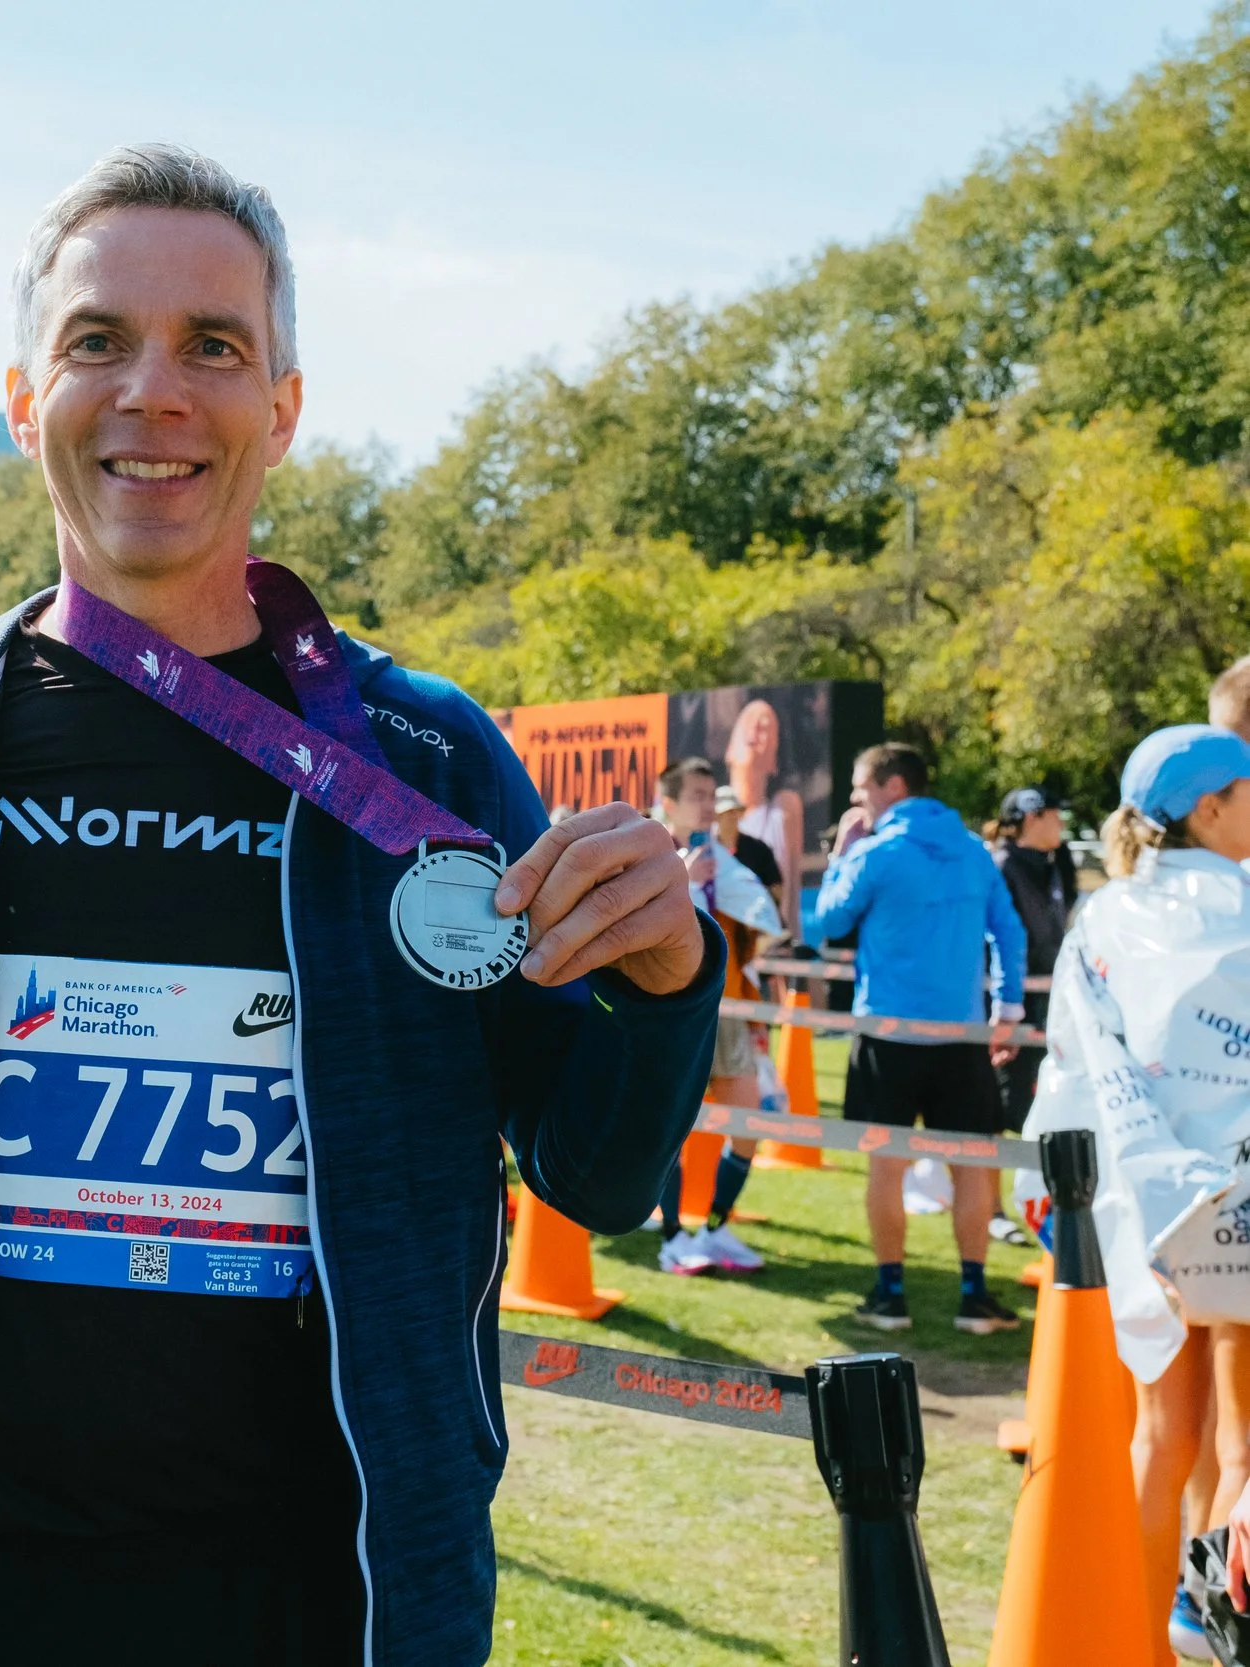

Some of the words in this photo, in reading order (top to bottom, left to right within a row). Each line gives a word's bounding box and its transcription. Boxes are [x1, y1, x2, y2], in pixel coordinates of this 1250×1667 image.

[165, 665, 177, 689] Chicago
[168, 666, 183, 695] Marathon
[316, 761, 332, 785] Chicago
[320, 762, 339, 792] Marathon
[65, 980, 95, 990] BANK
[97, 983, 111, 992] OF
[113, 984, 163, 995] AMERICA
[63, 995, 139, 1020] Chicago
[61, 1015, 156, 1038] Marathon
[76, 1064, 306, 1177] 7752
[77, 1187, 145, 1207] October
[151, 1193, 175, 1211] 13,
[180, 1195, 223, 1212] 2024
[33, 1245, 55, 1262] 24
[206, 1252, 237, 1261] Suggested
[212, 1268, 240, 1281] Gate
[244, 1270, 251, 1281] 3
[273, 1260, 293, 1277] 16
[204, 1280, 225, 1292] Van
[228, 1282, 258, 1293] Buren
[615, 1362, 712, 1407] Chicago
[715, 1378, 783, 1415] 2024
